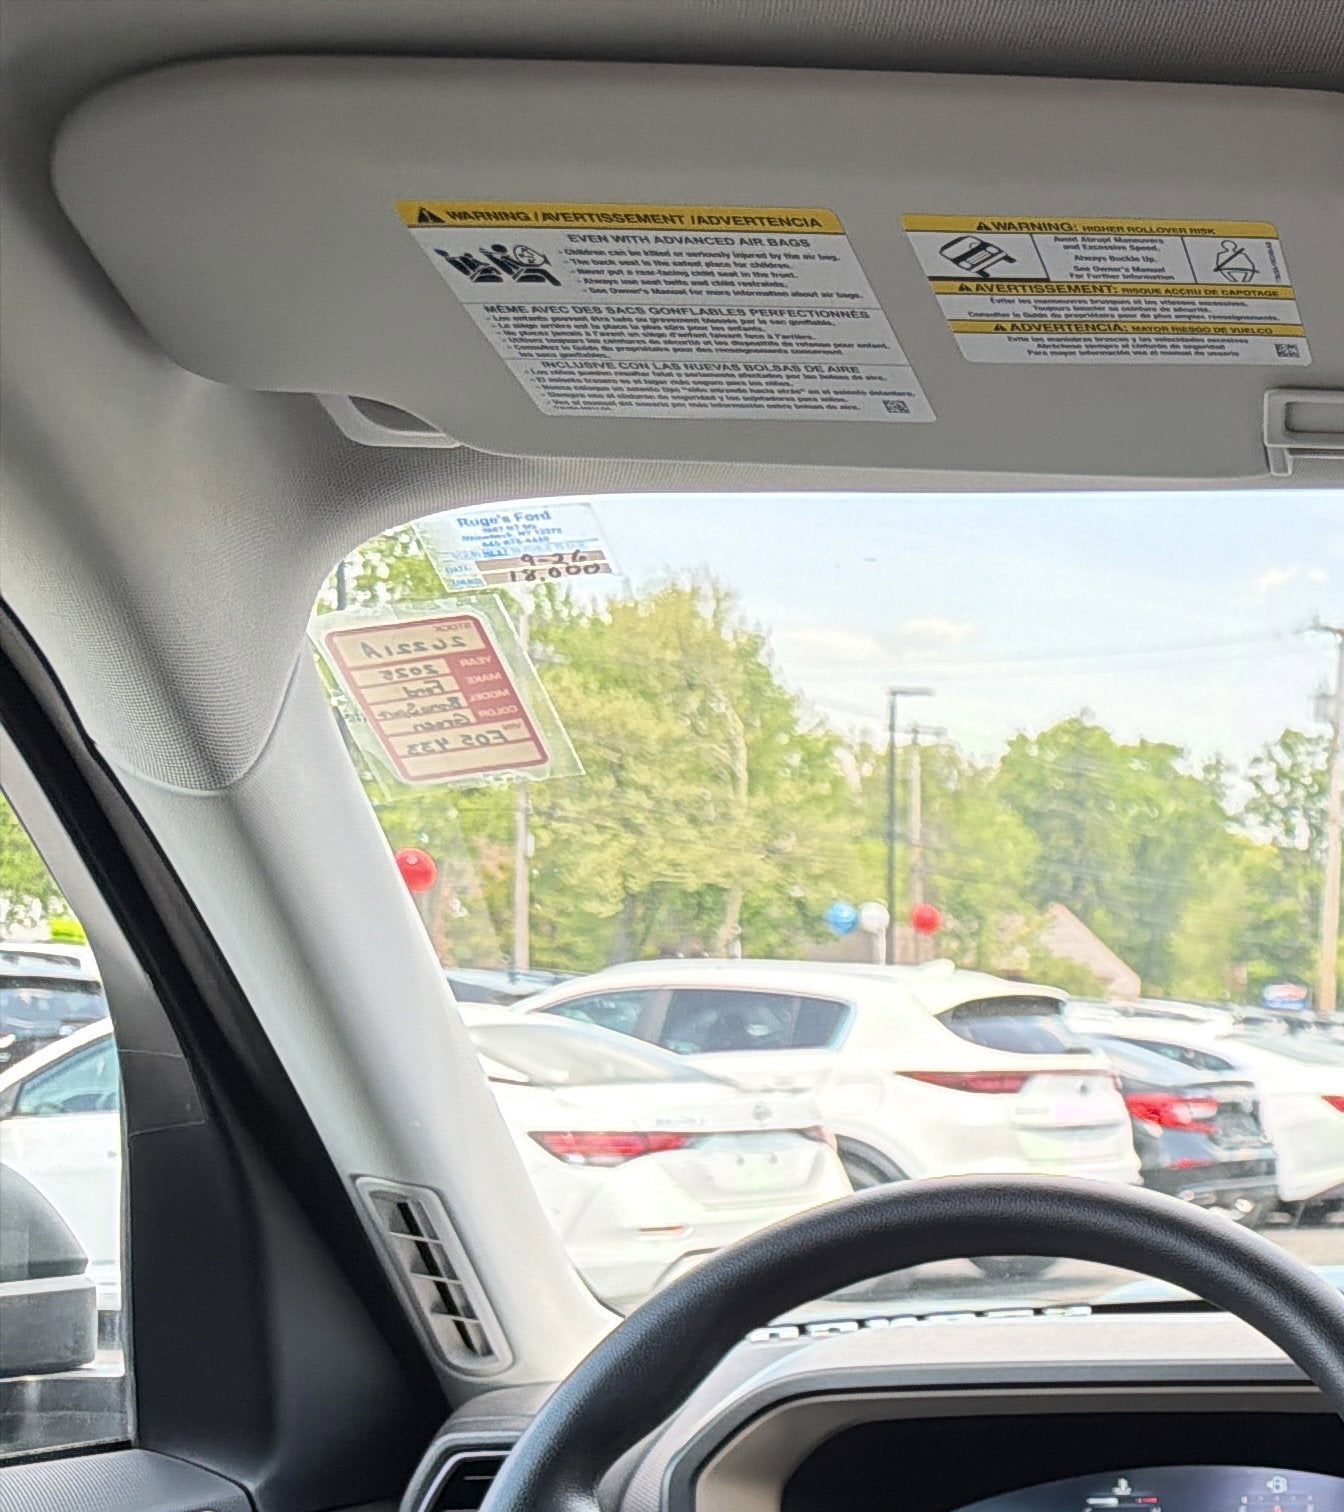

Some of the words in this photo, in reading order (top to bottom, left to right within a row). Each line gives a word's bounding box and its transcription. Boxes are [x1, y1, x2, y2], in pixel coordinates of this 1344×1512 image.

[446, 211, 529, 222] WARNING
[991, 221, 1078, 231] WARNING:
[567, 234, 608, 244] EVEN
[610, 234, 650, 245] WITH
[654, 236, 735, 246] ADVANCED
[739, 237, 763, 247] AIR
[767, 238, 810, 248] BAGS
[975, 284, 1118, 295] AVERTISSEMENT:
[531, 305, 569, 314] AVEC
[571, 306, 603, 315] DES
[606, 306, 647, 315] SACS
[648, 307, 746, 318] GONFLABLES
[1009, 323, 1128, 332] ADVERTENCIA:
[541, 361, 616, 370] INCLUSIVE
[620, 361, 649, 370] CON
[654, 362, 680, 371] LAS
[683, 363, 741, 372] NUEVAS
[744, 364, 799, 372] BOLSAS
[804, 365, 824, 373] DE
[827, 365, 861, 374] AIRE
[513, 510, 551, 522] Ford
